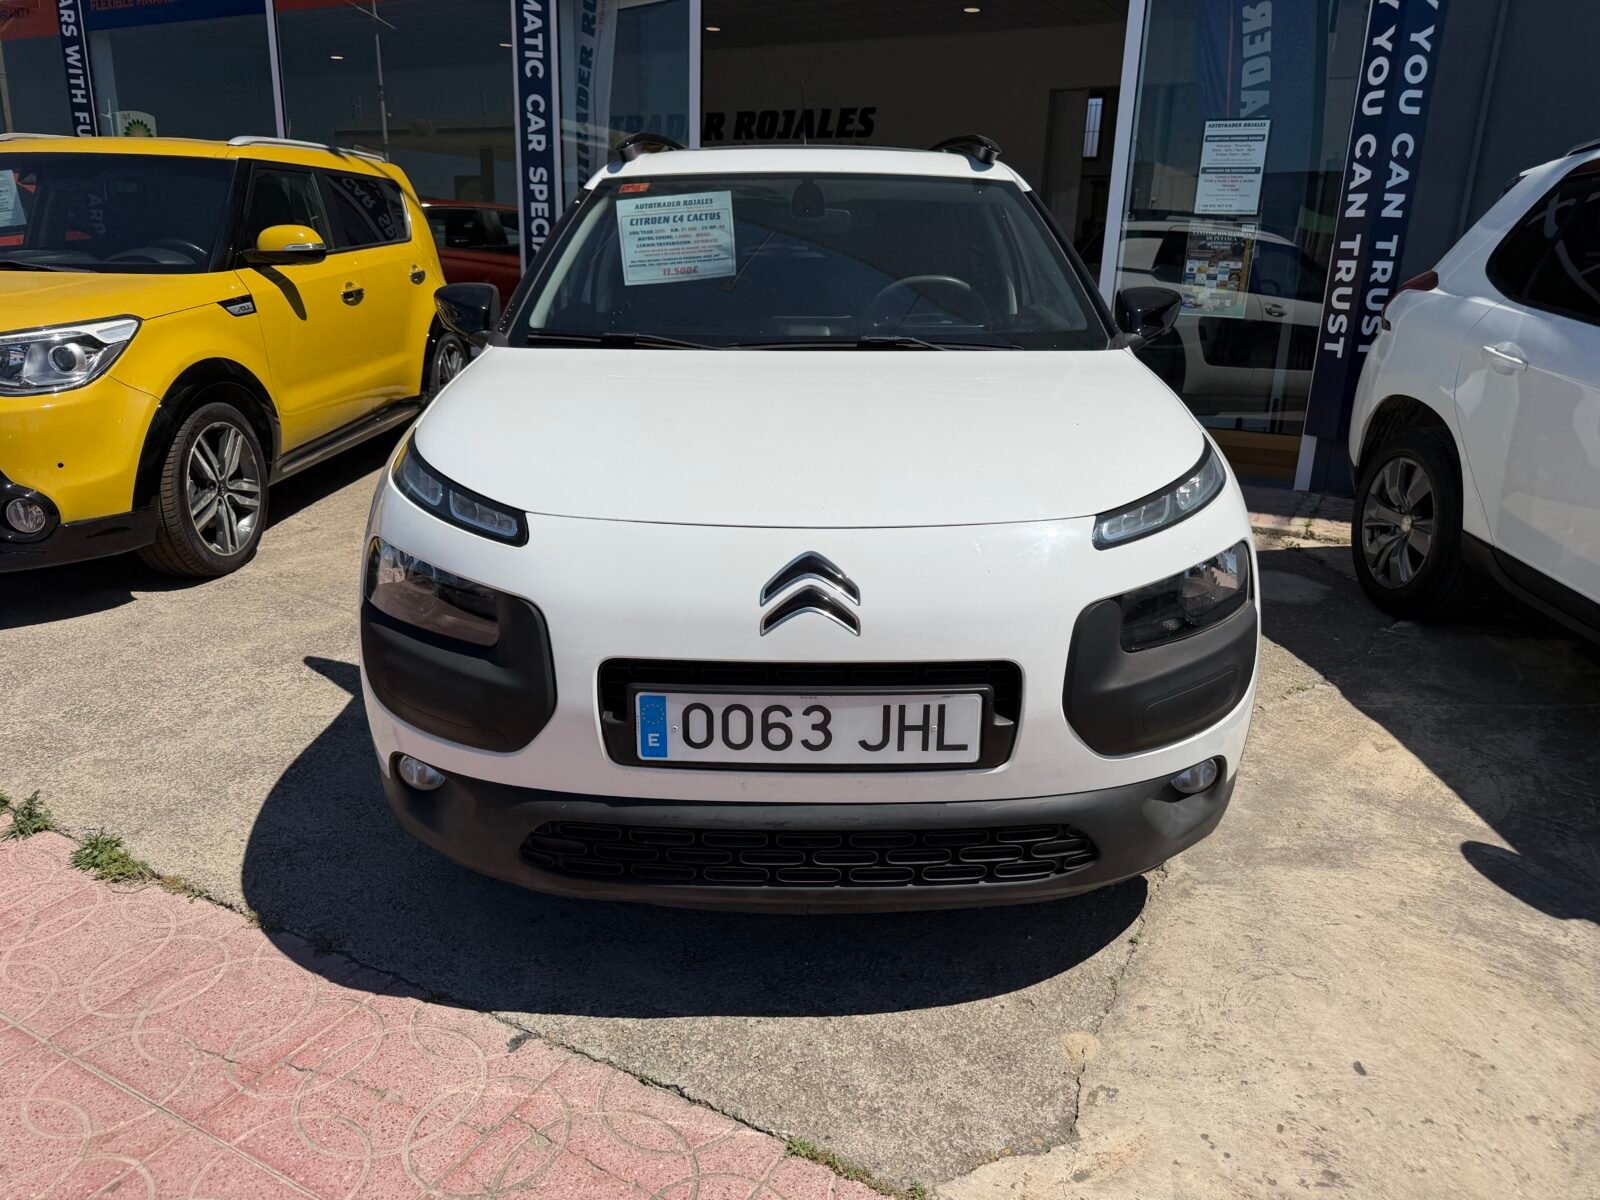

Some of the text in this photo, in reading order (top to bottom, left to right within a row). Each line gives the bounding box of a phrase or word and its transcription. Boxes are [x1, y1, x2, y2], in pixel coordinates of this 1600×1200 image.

[65, 45, 87, 104] WITH
[1362, 24, 1396, 116] YOU
[1399, 24, 1435, 115] YOU
[526, 94, 547, 152] CAR
[733, 107, 877, 141] ROJALES
[634, 198, 713, 210] AUTOTRADER ROJALES
[1344, 133, 1377, 218] CAN
[1381, 132, 1415, 218] CAN
[629, 212, 721, 226] CITROEN C4 CACTUS
[1324, 233, 1361, 359] TRUST
[647, 733, 660, 747] E
[682, 703, 969, 752] 0063 JHL
